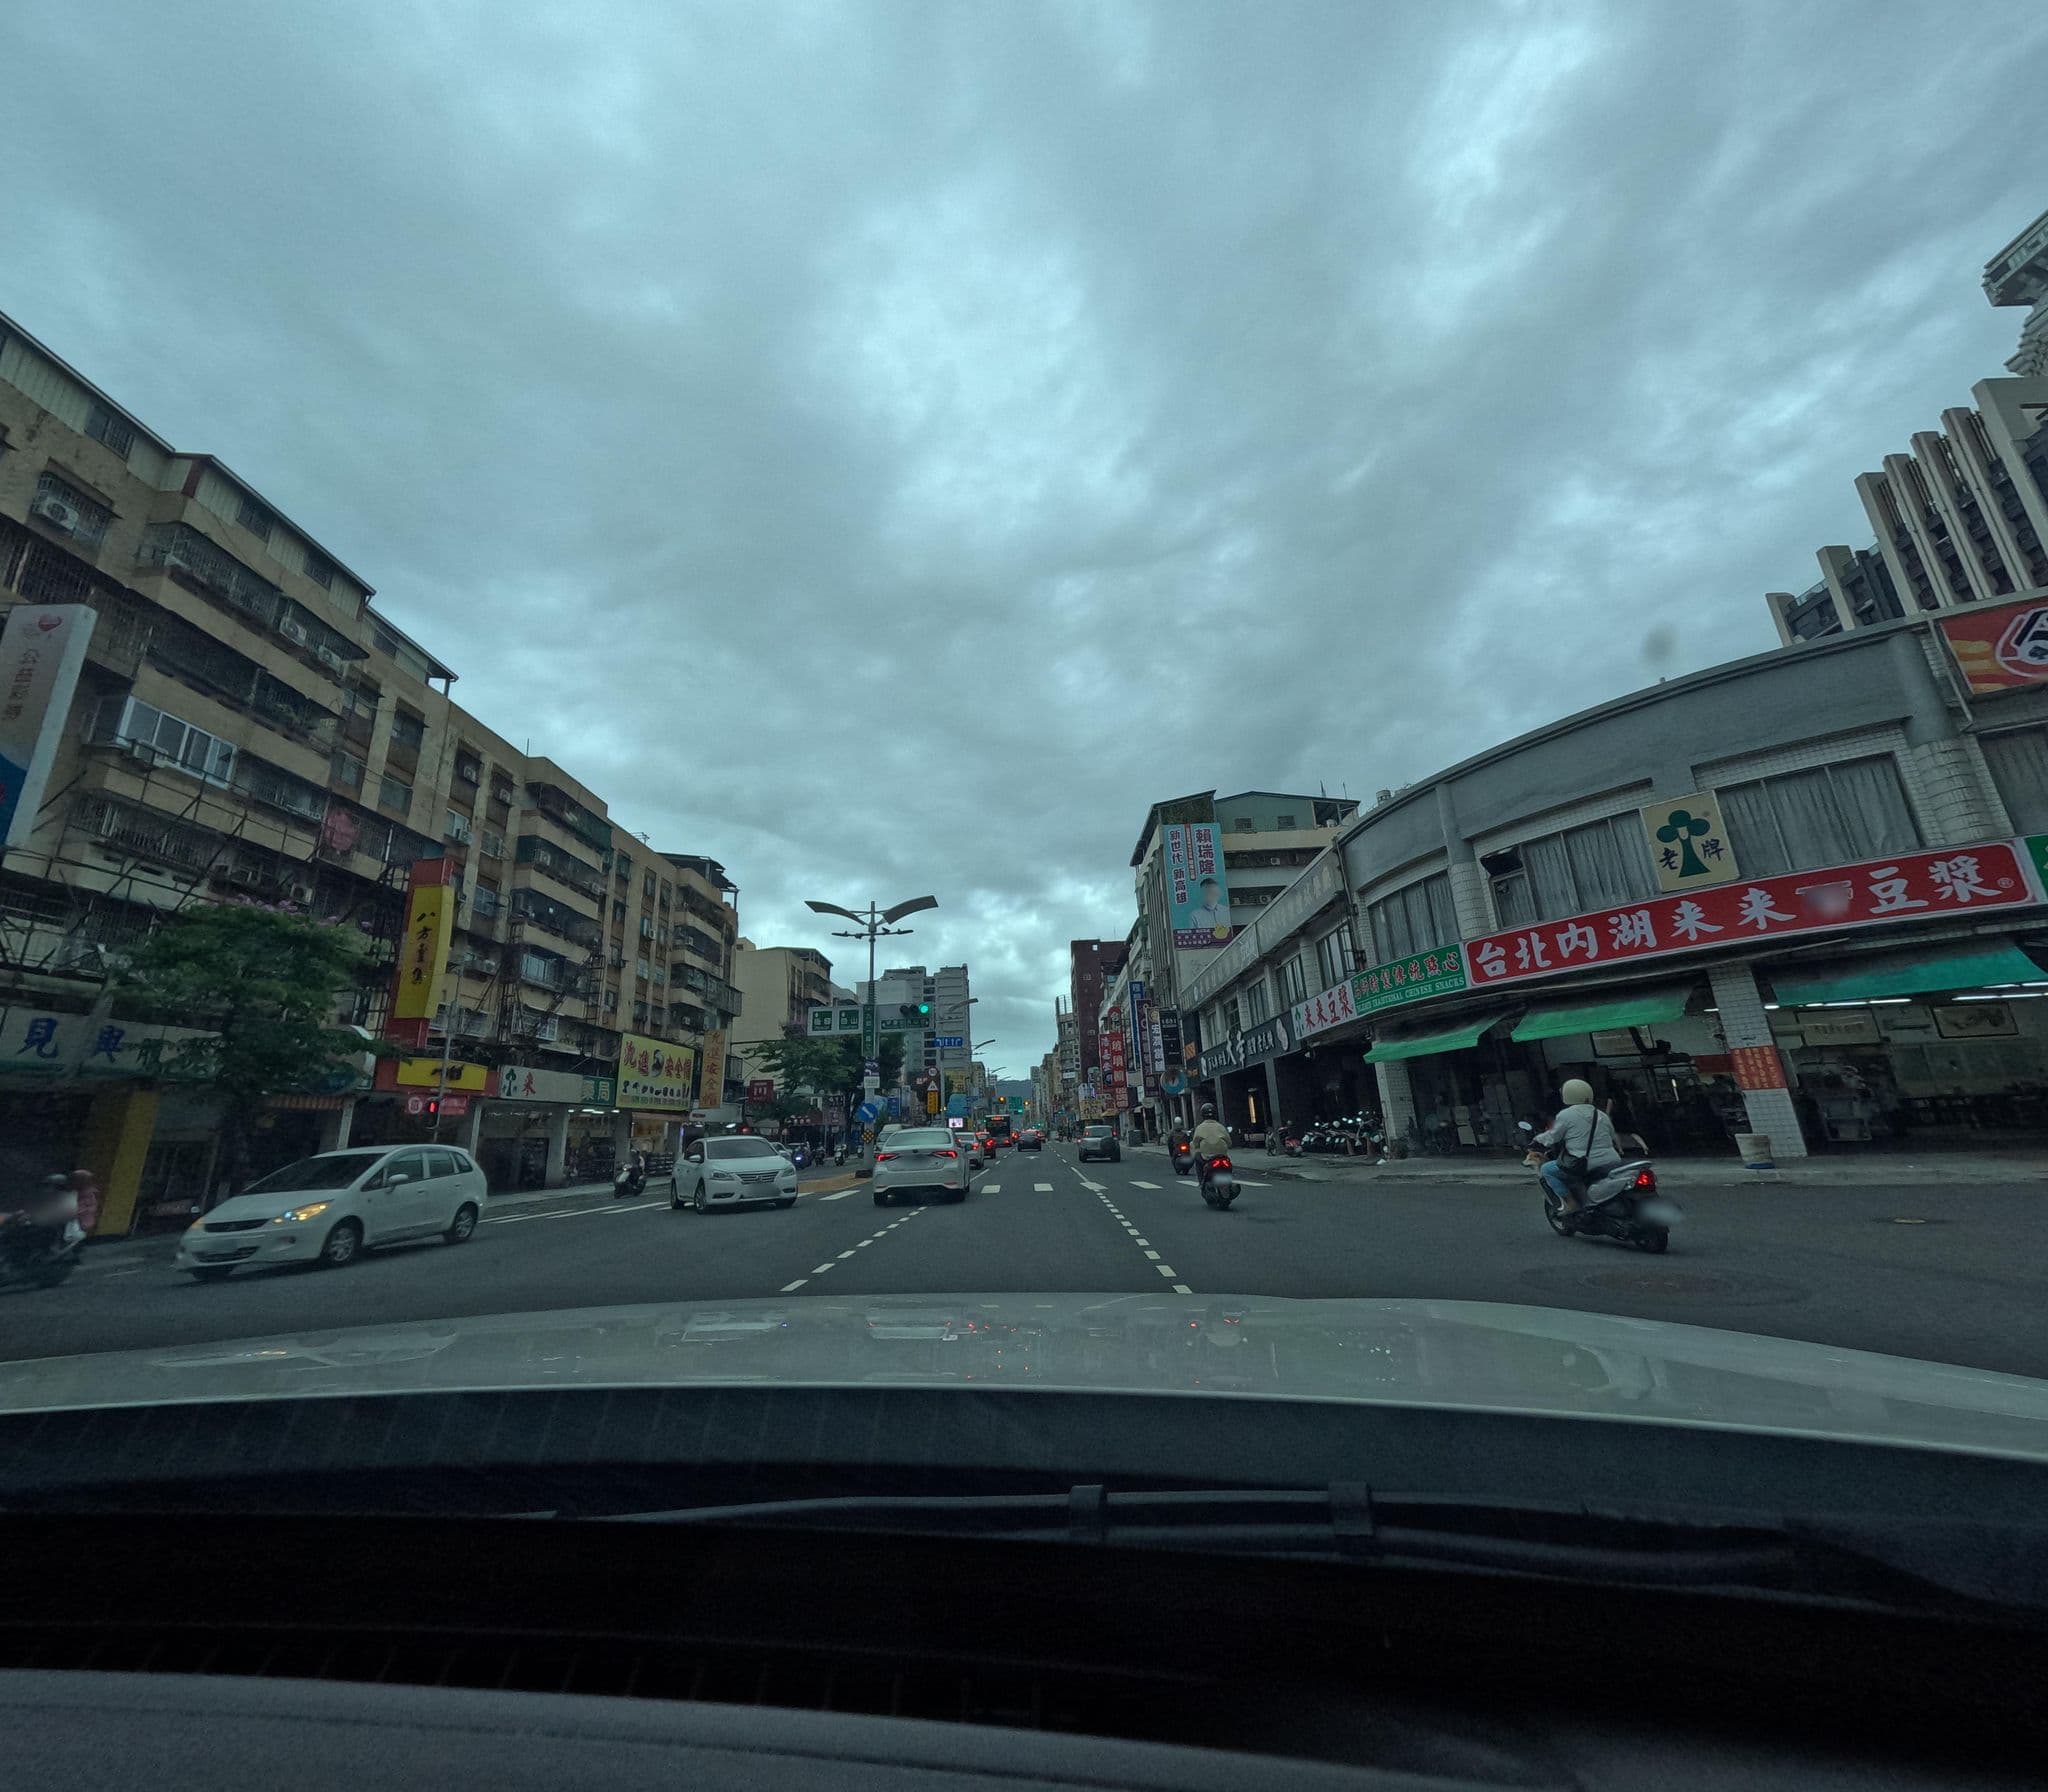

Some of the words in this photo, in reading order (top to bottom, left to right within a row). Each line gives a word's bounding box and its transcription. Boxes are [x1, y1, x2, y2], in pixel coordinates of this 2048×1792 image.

[1170, 829, 1183, 864] 新世代
[1195, 828, 1215, 875] 賴瑞隆
[1174, 868, 1187, 904] 新高雄
[1869, 855, 2003, 914] 豆漿
[1405, 984, 1434, 999] CHINESE
[1435, 977, 1465, 991] SNACKS
